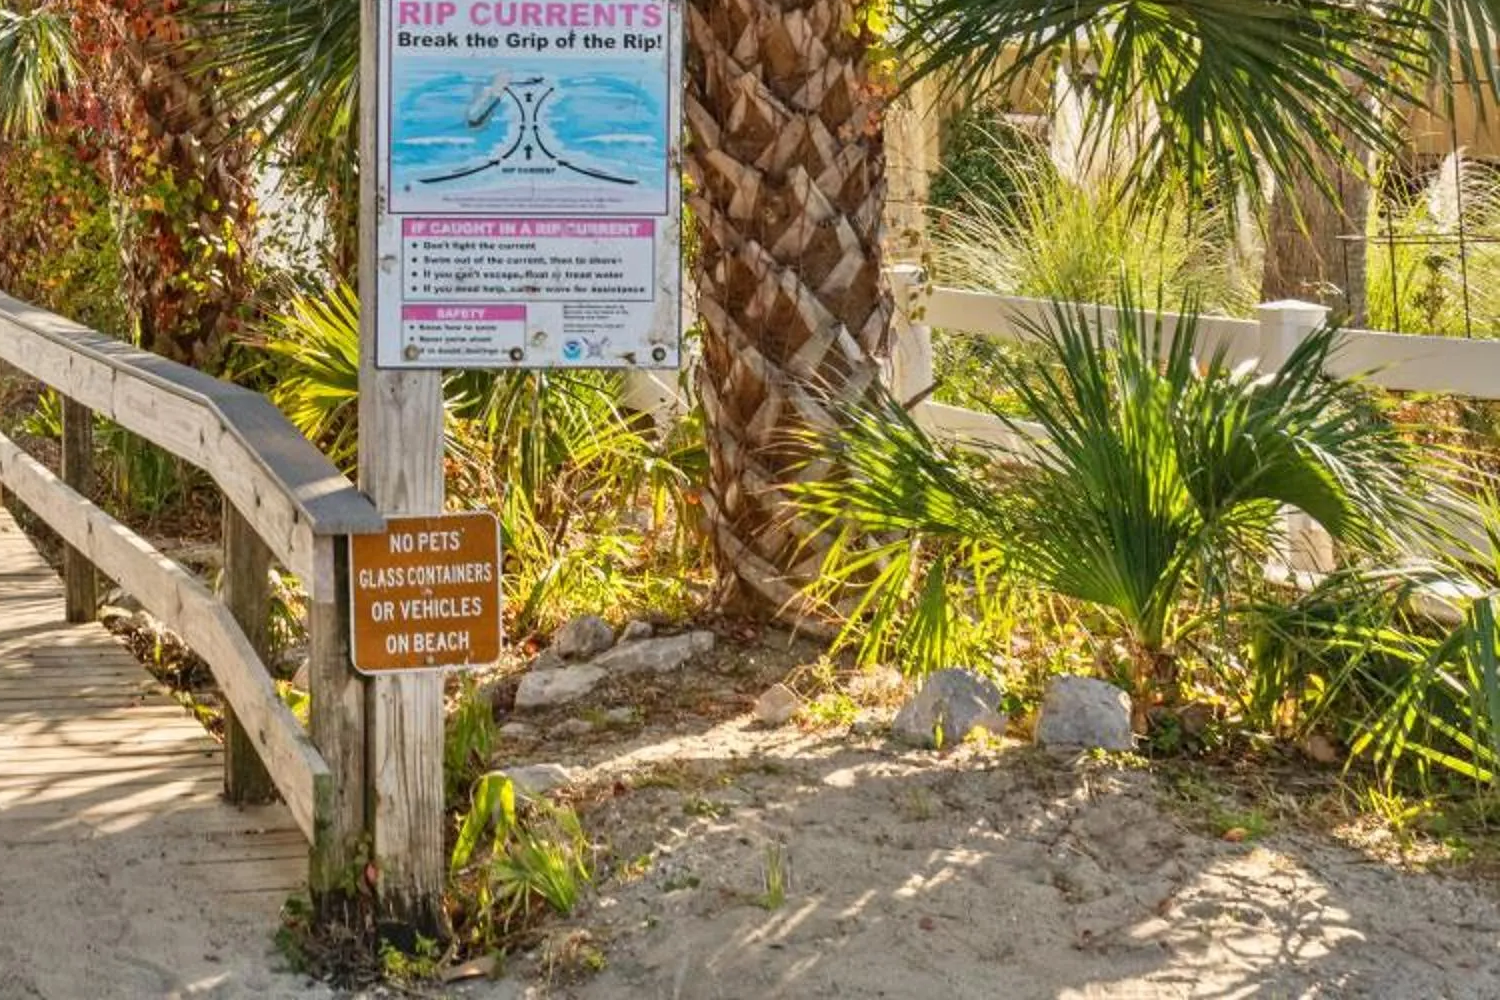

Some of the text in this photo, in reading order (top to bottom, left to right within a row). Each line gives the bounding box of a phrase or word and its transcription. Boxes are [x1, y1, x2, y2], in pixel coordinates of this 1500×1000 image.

[399, 0, 662, 28] RIP CURRENTS
[398, 32, 662, 53] Break the Grip of the Rip!
[430, 222, 496, 235] CAUGHT
[519, 222, 533, 235] A
[389, 531, 461, 553] NO PETS
[359, 562, 492, 590] GLASS CONTAINERS
[371, 597, 482, 622] OR VEHICLES
[386, 631, 469, 654] ON BEACH
